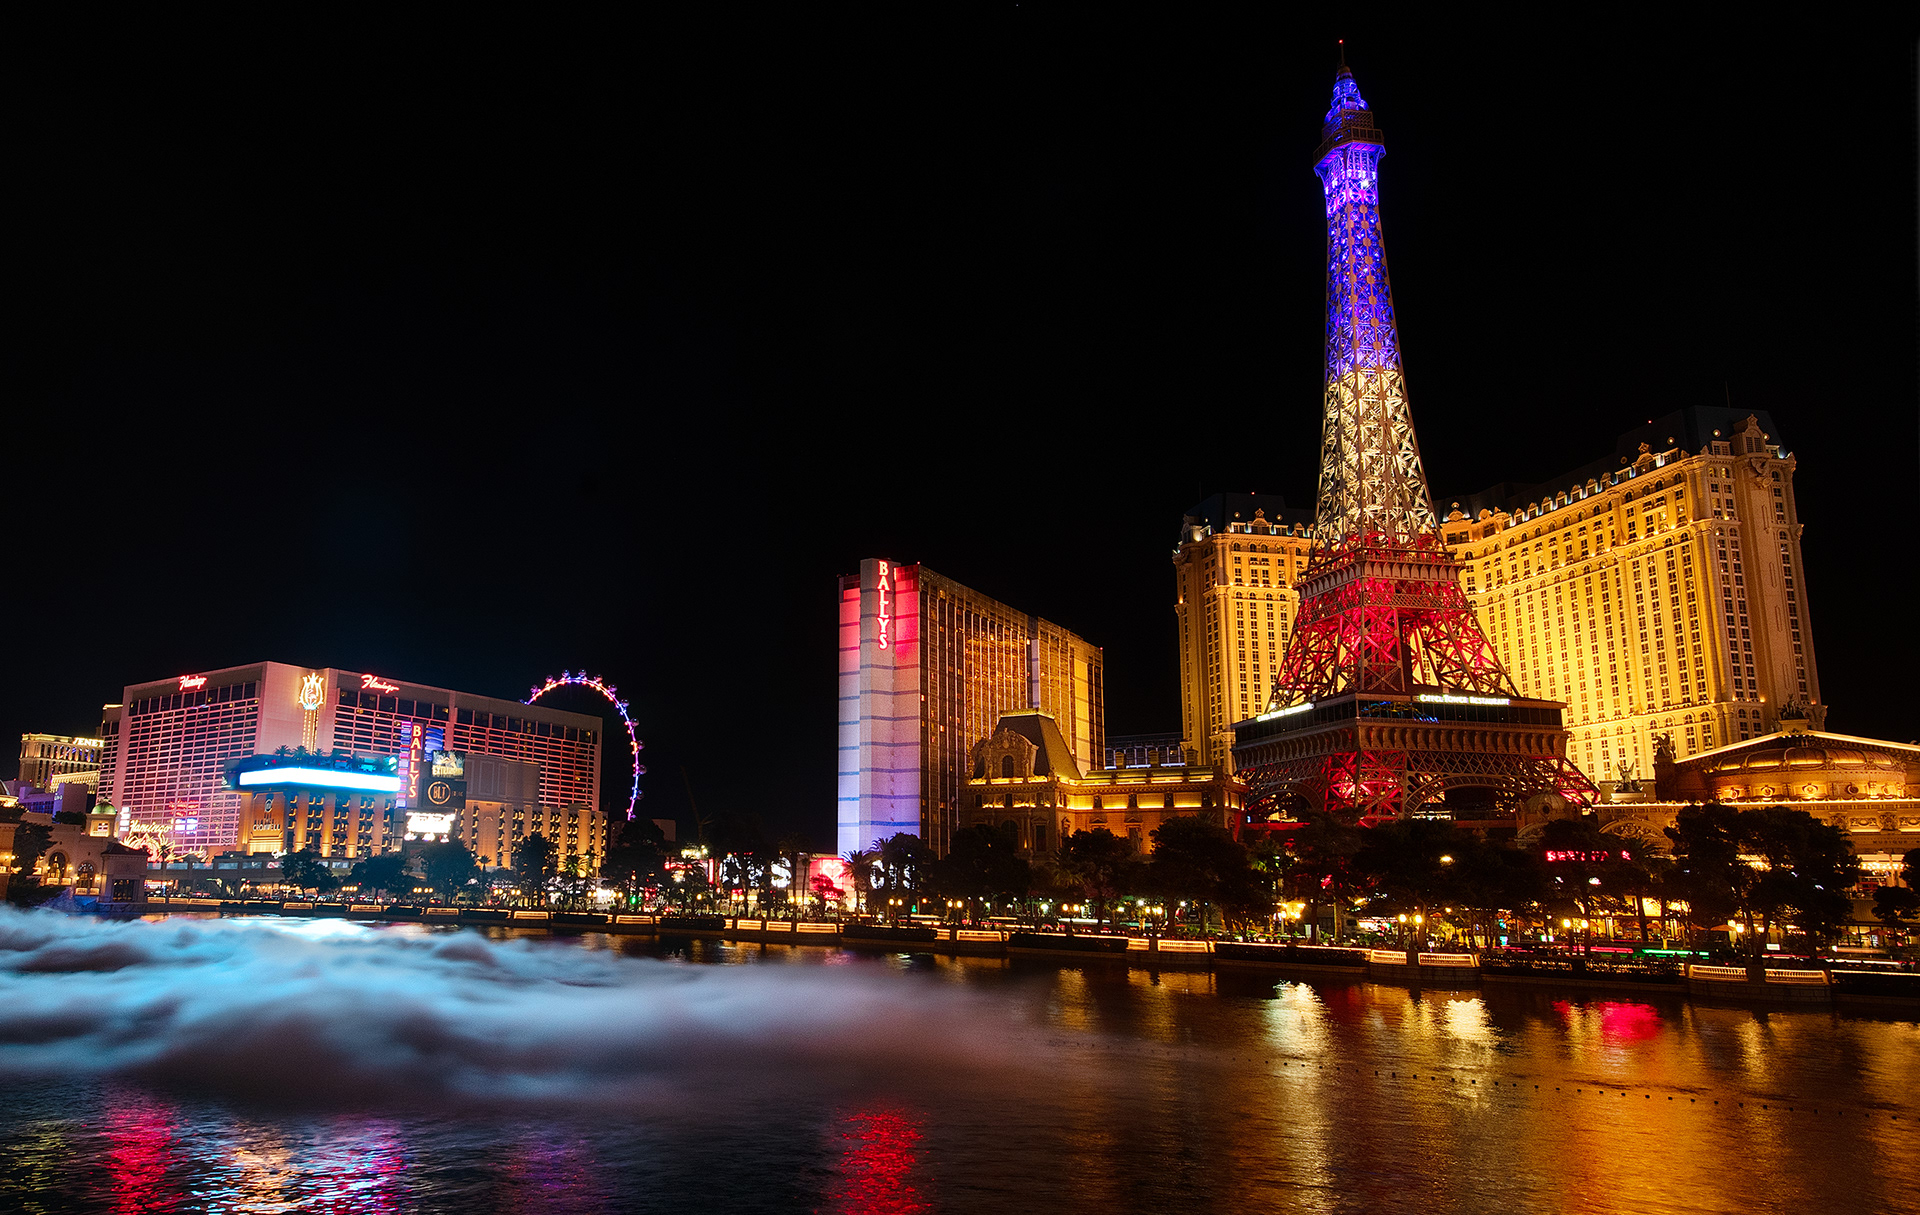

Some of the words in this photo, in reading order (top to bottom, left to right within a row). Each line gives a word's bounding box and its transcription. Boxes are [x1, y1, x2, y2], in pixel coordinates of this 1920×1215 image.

[179, 674, 207, 691] Flamingo
[360, 674, 400, 694] Flamingo
[1443, 694, 1468, 704] TOWER
[1469, 696, 1510, 705] RESTAURANT
[433, 785, 446, 799] BLT
